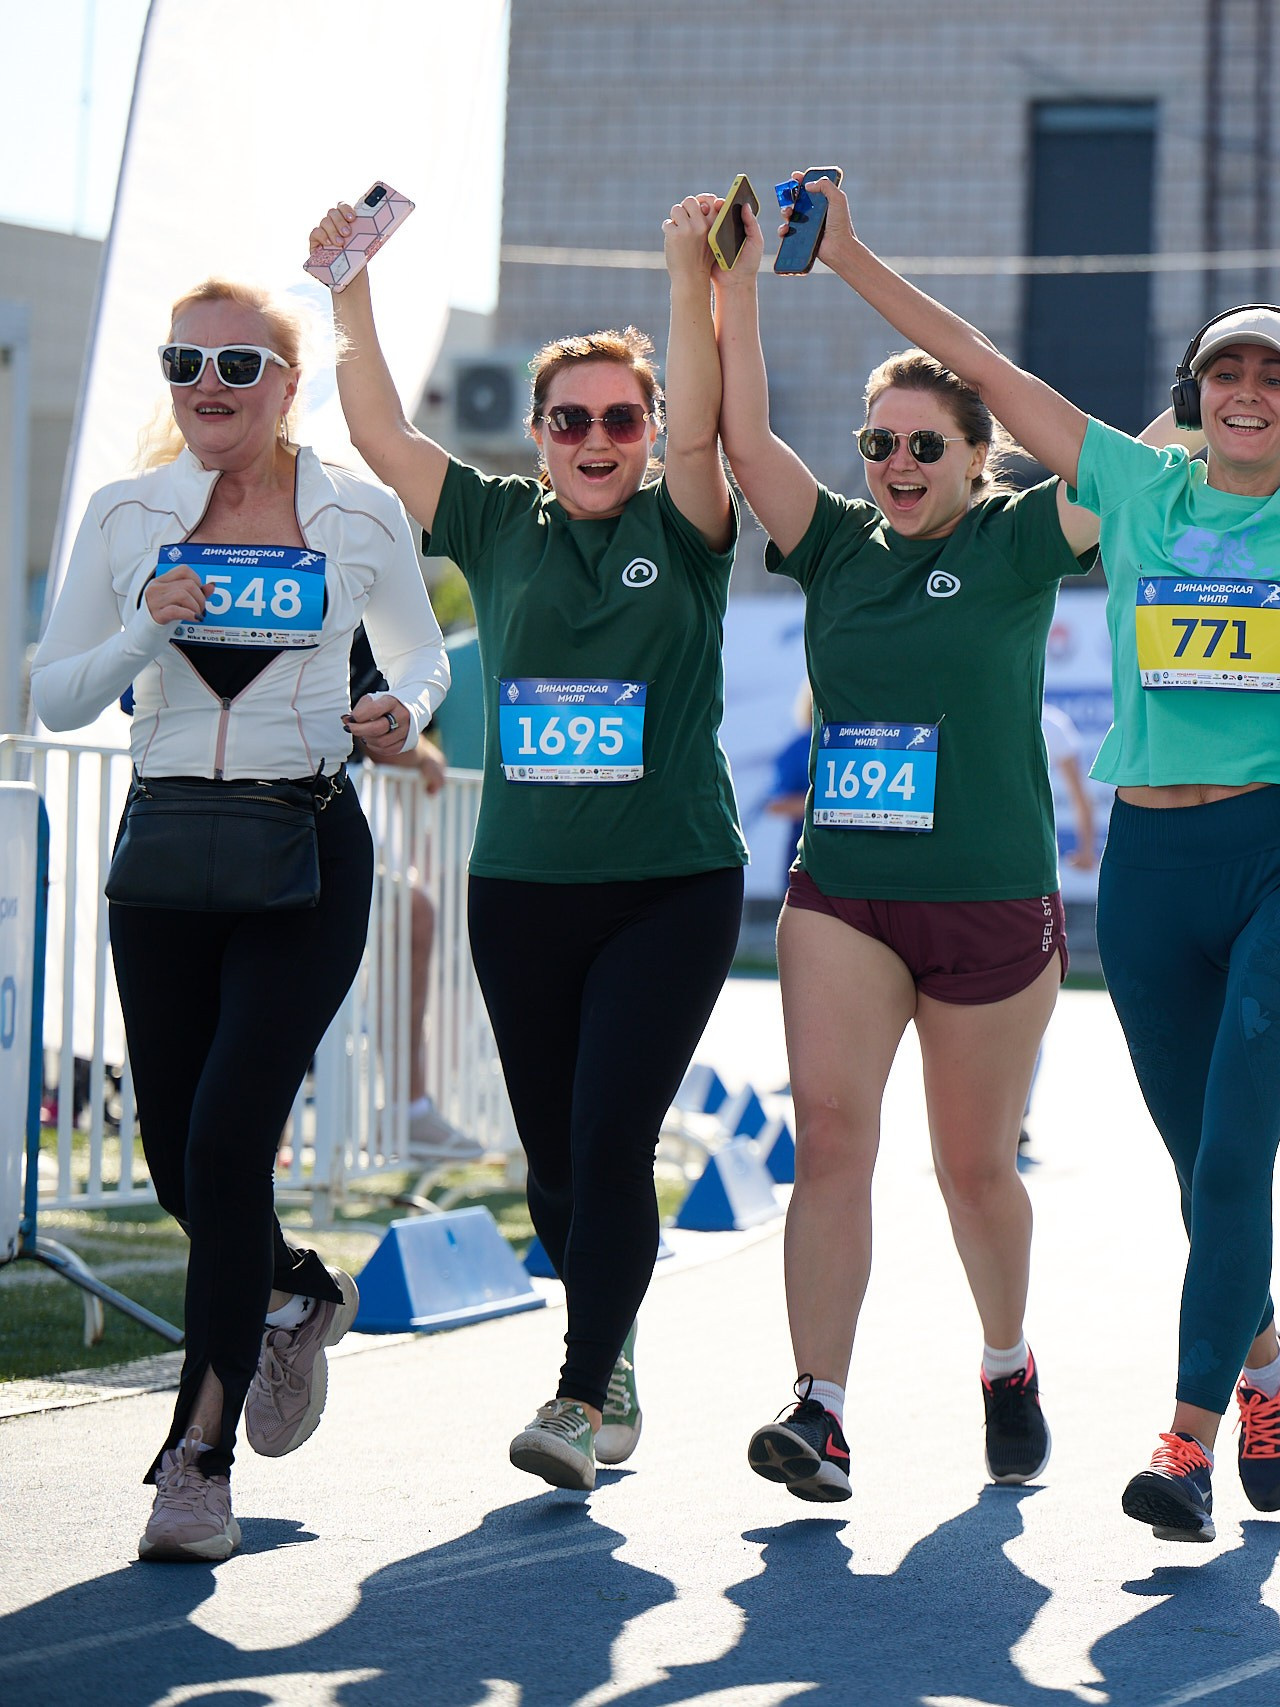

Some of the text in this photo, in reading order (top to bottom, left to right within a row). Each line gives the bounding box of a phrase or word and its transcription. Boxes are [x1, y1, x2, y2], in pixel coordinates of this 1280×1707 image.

[202, 548, 285, 558] ДИНАМОВСКАЯ
[227, 557, 259, 565] МИЛЯ
[1174, 583, 1254, 594] ДИНАМОВСКАЯ
[204, 575, 302, 619] 548
[1198, 594, 1229, 604] МИЛЯ
[1172, 618, 1252, 660] 771
[535, 684, 609, 694] ДИНАМОВСКАЯ
[558, 694, 585, 703] МИЛЯ
[518, 716, 624, 756] 1695
[838, 727, 901, 737] ДИНАМОВСКАЯ
[854, 738, 879, 747] МИЛЯ
[824, 760, 916, 801] 1694
[1042, 918, 1054, 952] FEEL
